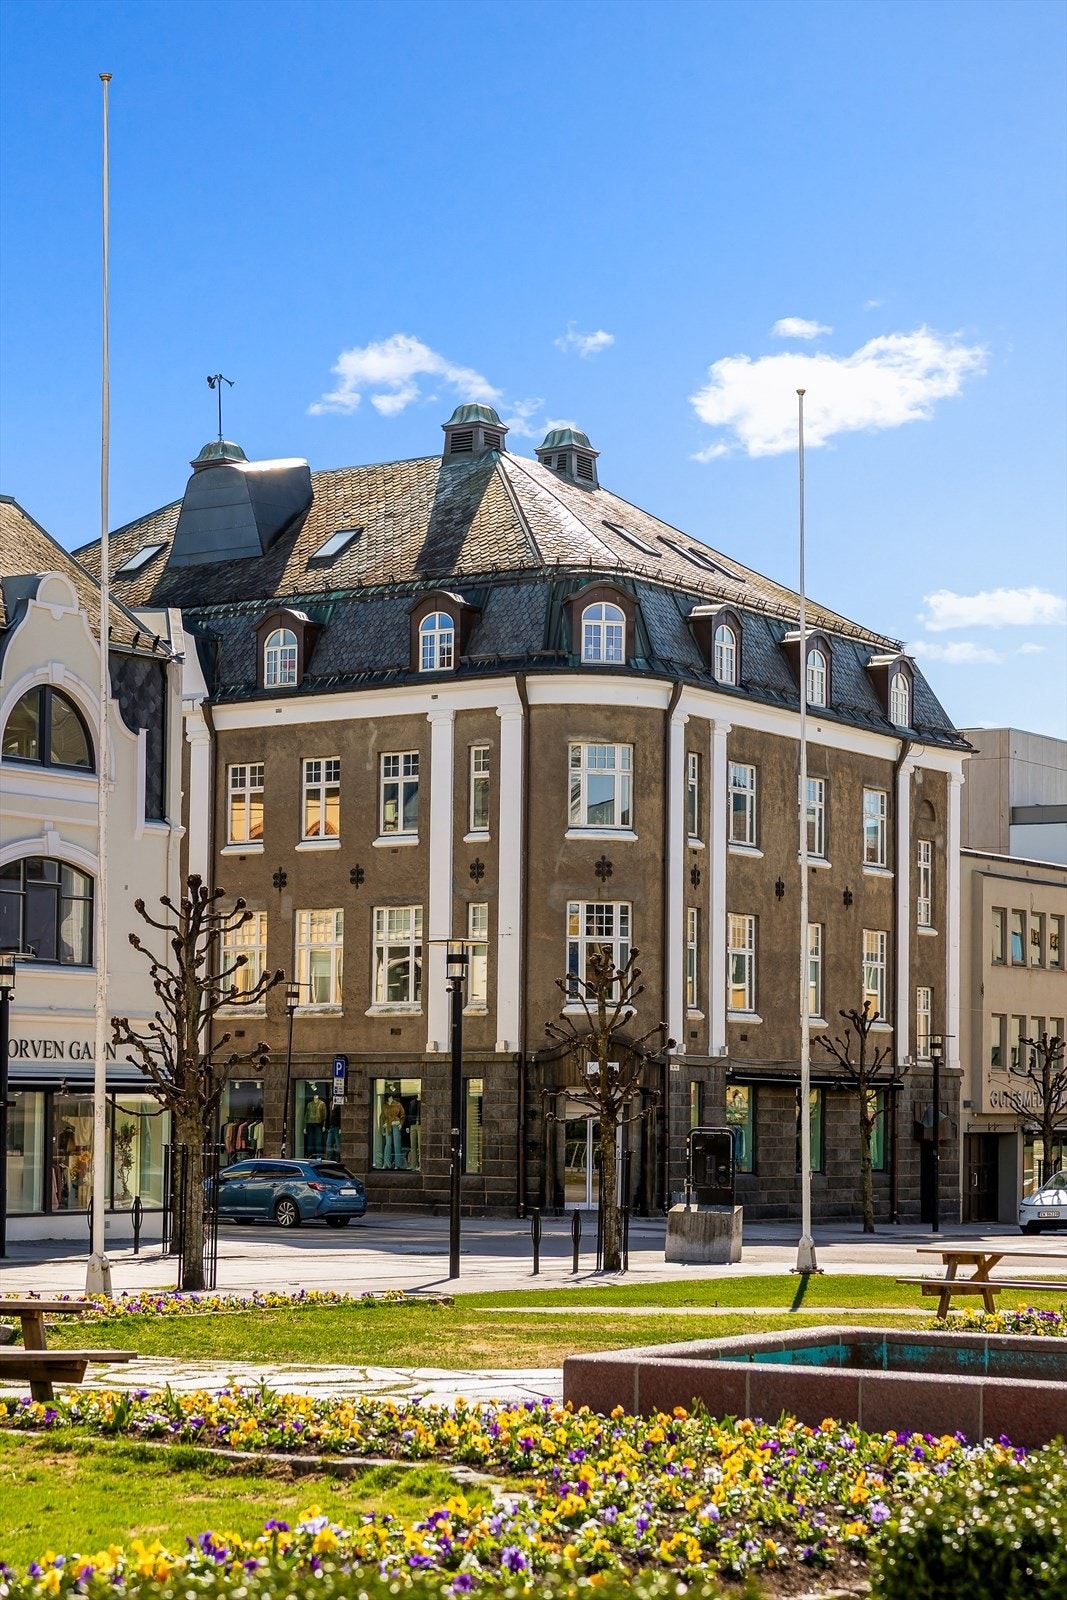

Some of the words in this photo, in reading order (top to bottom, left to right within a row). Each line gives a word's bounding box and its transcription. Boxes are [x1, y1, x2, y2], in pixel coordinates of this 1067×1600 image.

[7, 1039, 65, 1059] ORVEN
[69, 1041, 116, 1060] GAN
[336, 1062, 342, 1075] P
